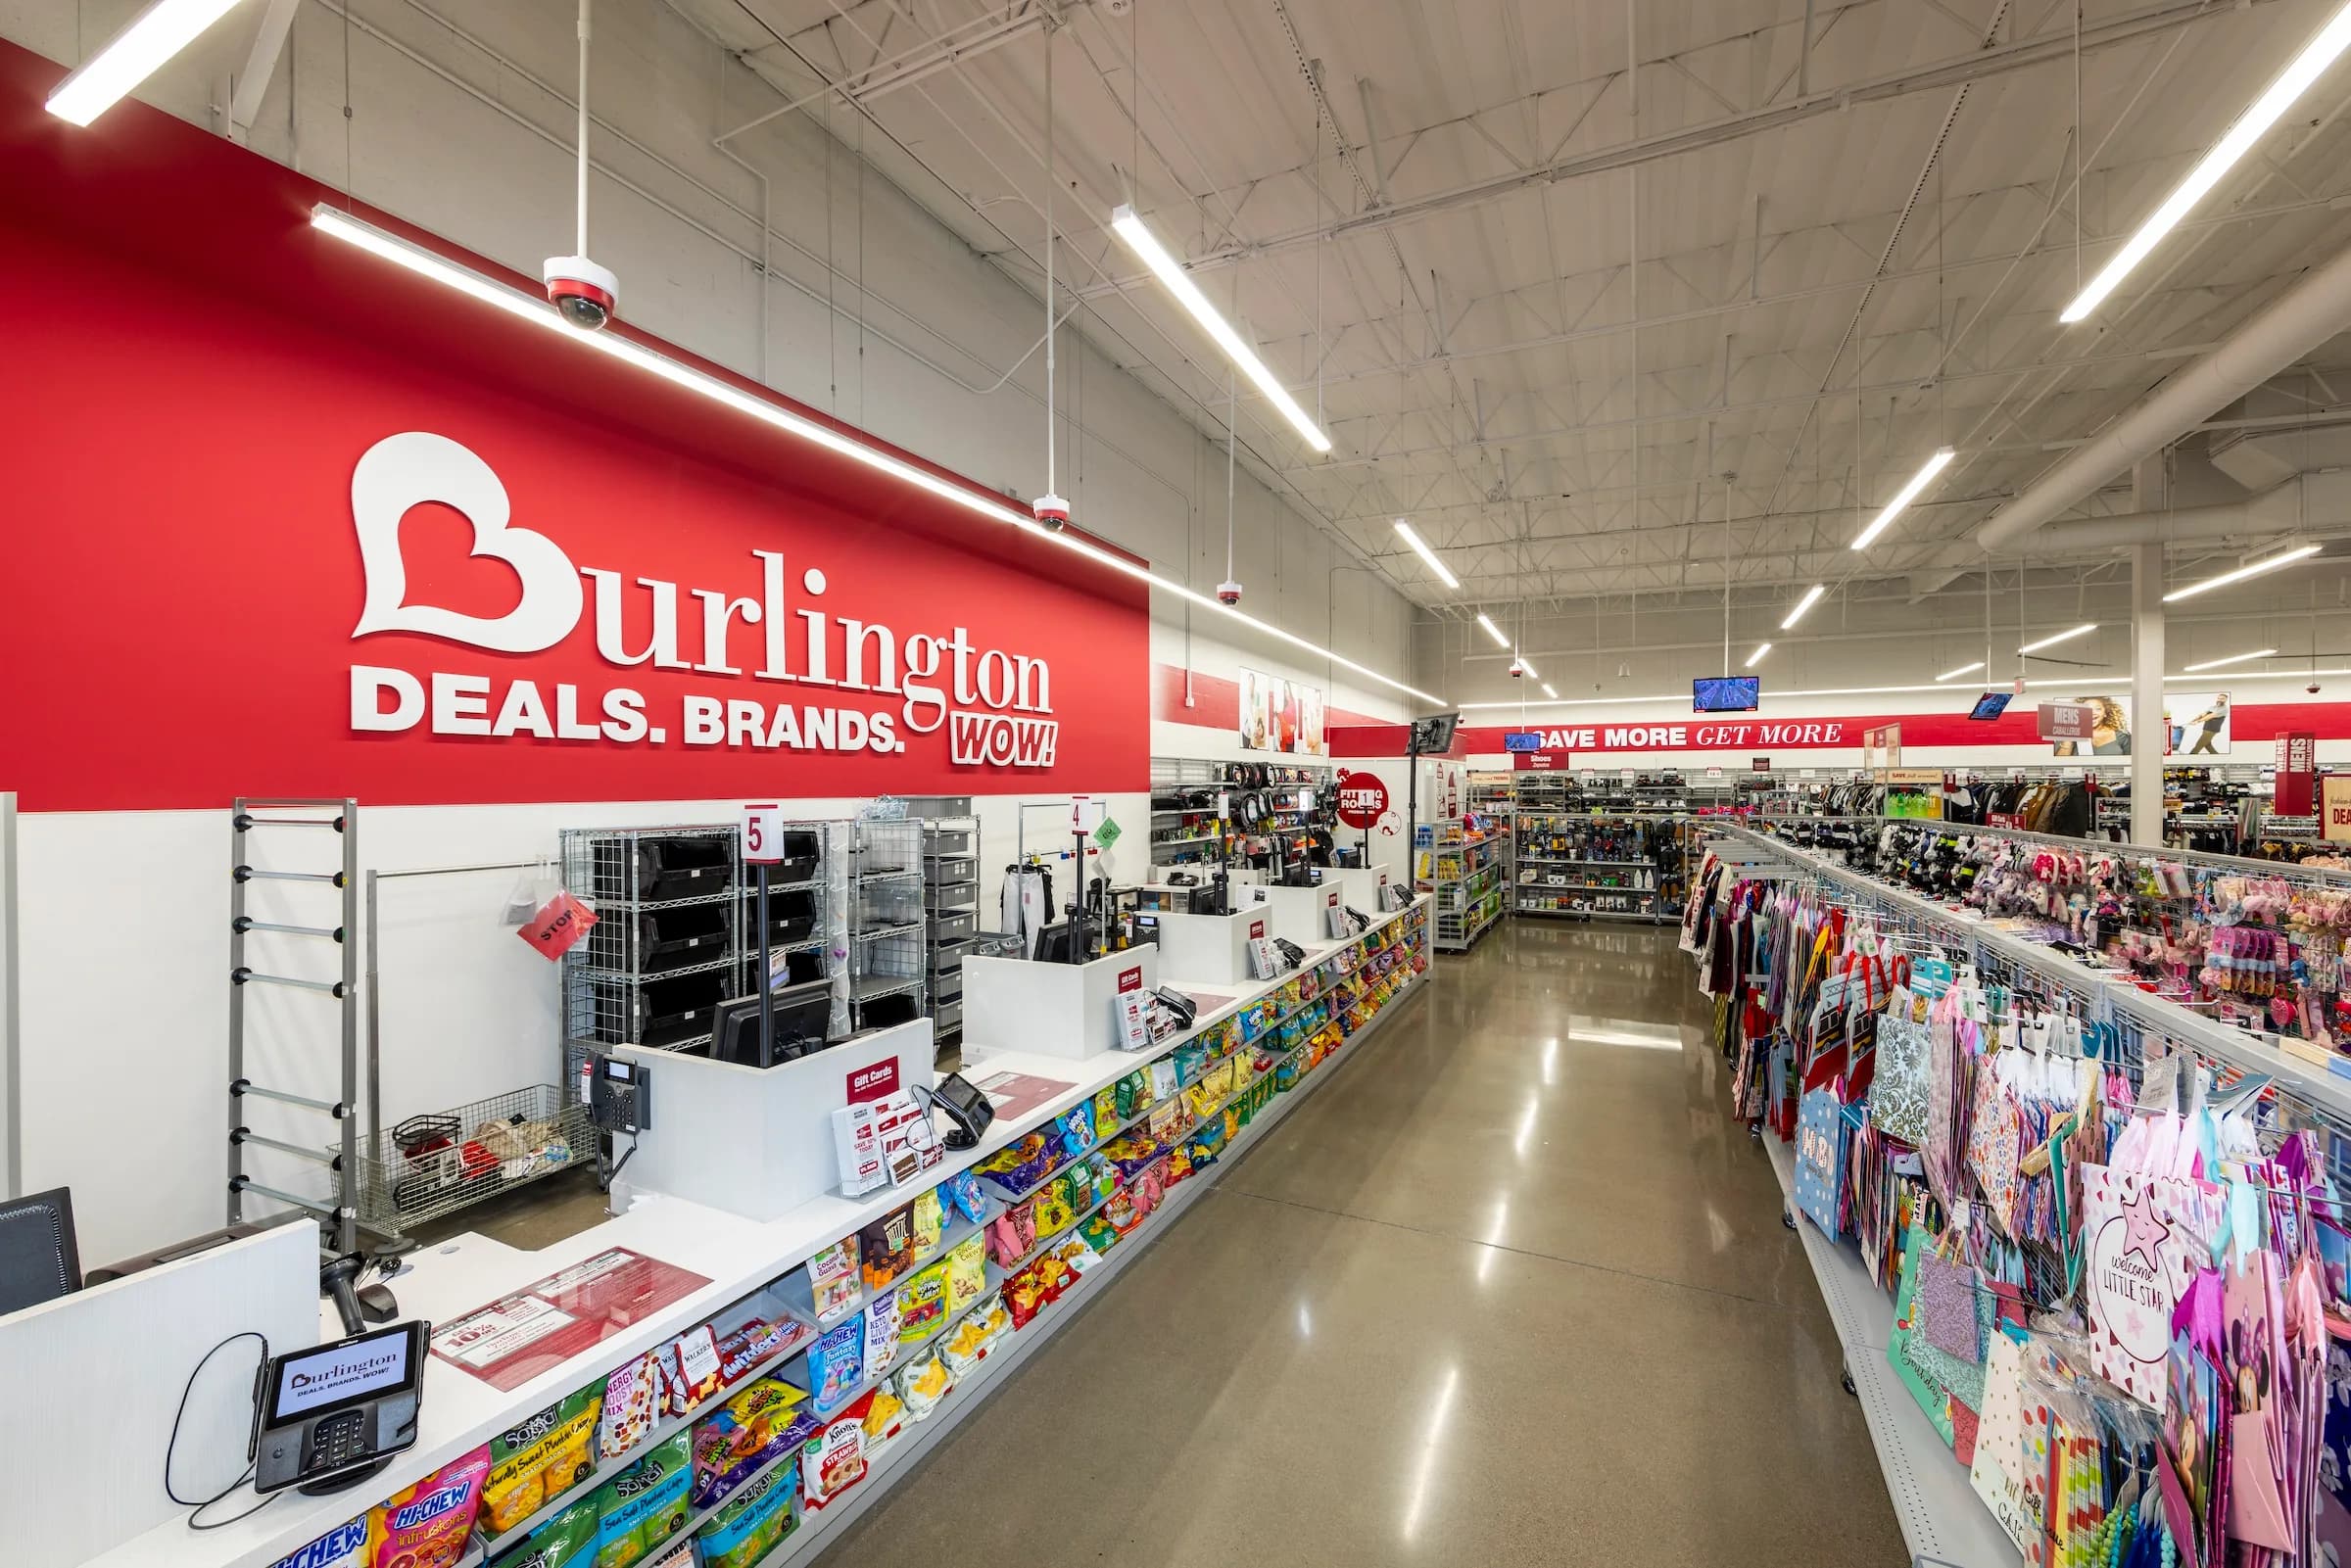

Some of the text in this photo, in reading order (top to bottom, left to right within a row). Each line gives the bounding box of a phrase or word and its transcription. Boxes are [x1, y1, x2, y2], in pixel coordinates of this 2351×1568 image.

[351, 431, 1054, 733] Burlington
[350, 664, 1059, 768] DEALS. BRANDS. WOW!
[2053, 707, 2080, 726] MENS
[1539, 723, 1843, 748] SAVE MORE GET MORE
[2289, 738, 2306, 773] MENS
[1340, 789, 1383, 799] FITG
[1073, 804, 1080, 827] 4
[747, 817, 762, 852] 5
[540, 909, 574, 942] STOP
[854, 1073, 869, 1088] Gift
[870, 1066, 892, 1081] Cards
[816, 1253, 840, 1271] Coconut
[818, 1263, 838, 1277] Guava
[2111, 1256, 2154, 1283] welcome
[2104, 1268, 2165, 1316] LITTLE STAR
[870, 1315, 888, 1329] KETO
[825, 1344, 857, 1365] fantasy
[870, 1336, 886, 1347] MIX
[290, 1354, 397, 1391] Burlington
[298, 1366, 390, 1398] DEALS. BRANDS. WOW!
[607, 1369, 634, 1396] NERGY
[607, 1383, 633, 1406] OOST
[482, 1463, 517, 1493] Naturally
[517, 1447, 545, 1471] Sweet
[393, 1481, 471, 1530] HI-CHEW
[604, 1515, 621, 1532] Sea
[622, 1504, 638, 1524] Salt
[731, 1521, 744, 1536] Sea
